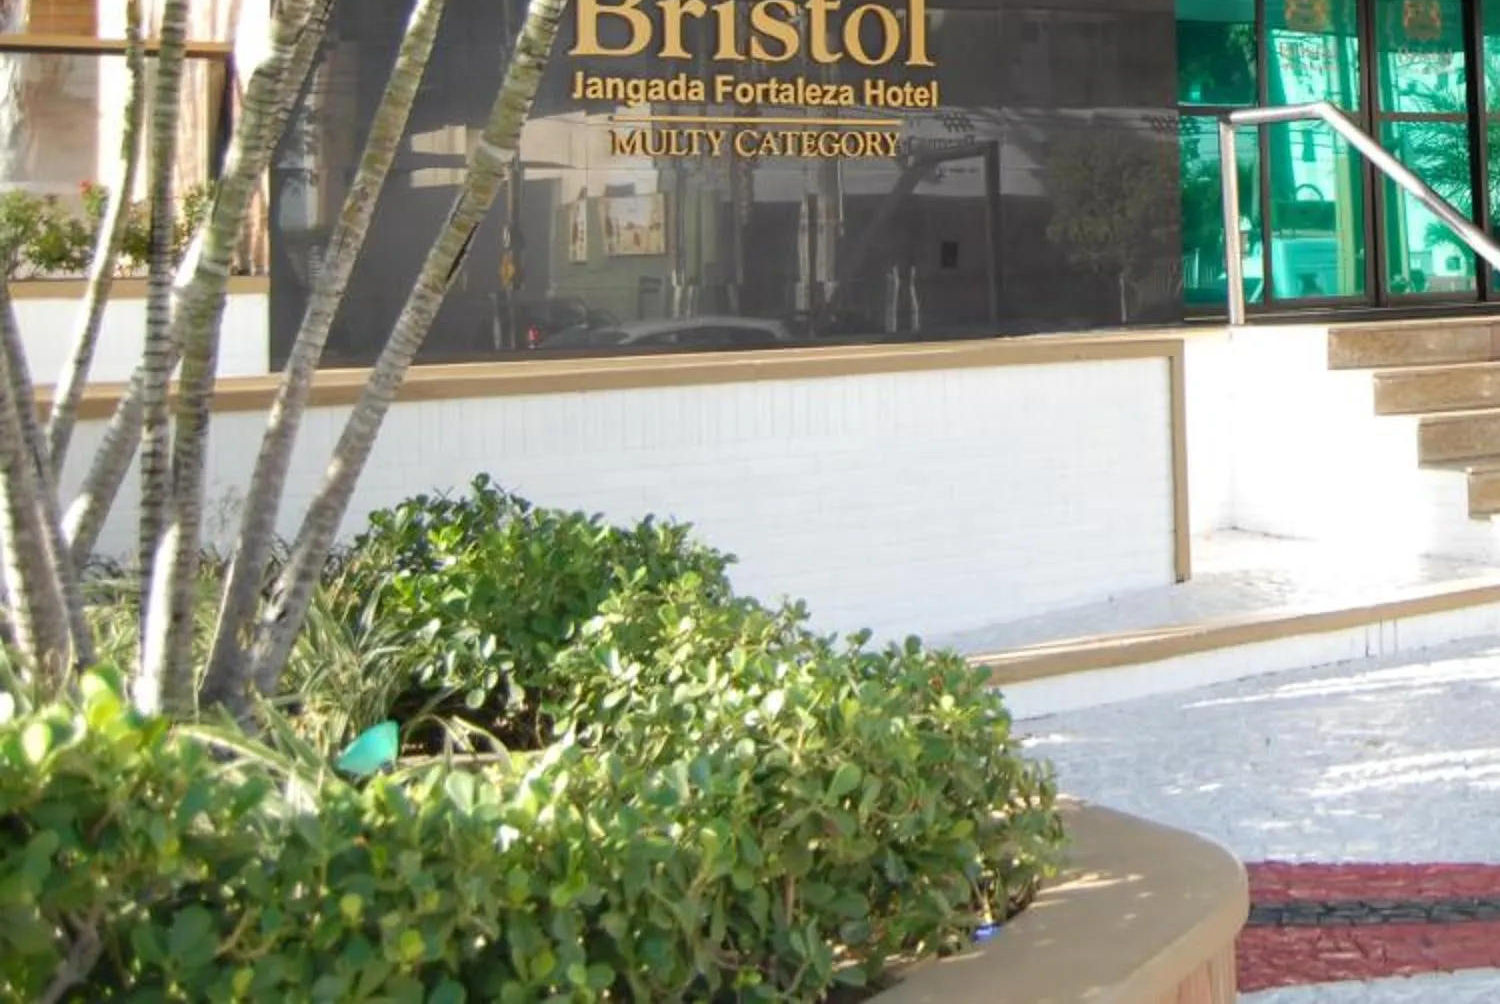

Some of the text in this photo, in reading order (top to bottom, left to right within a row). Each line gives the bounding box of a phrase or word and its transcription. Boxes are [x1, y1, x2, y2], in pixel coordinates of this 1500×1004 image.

[573, 71, 938, 108] Jangada Fortaleza Hotel
[609, 128, 727, 157] MULTY
[734, 129, 900, 158] CATEGORY
